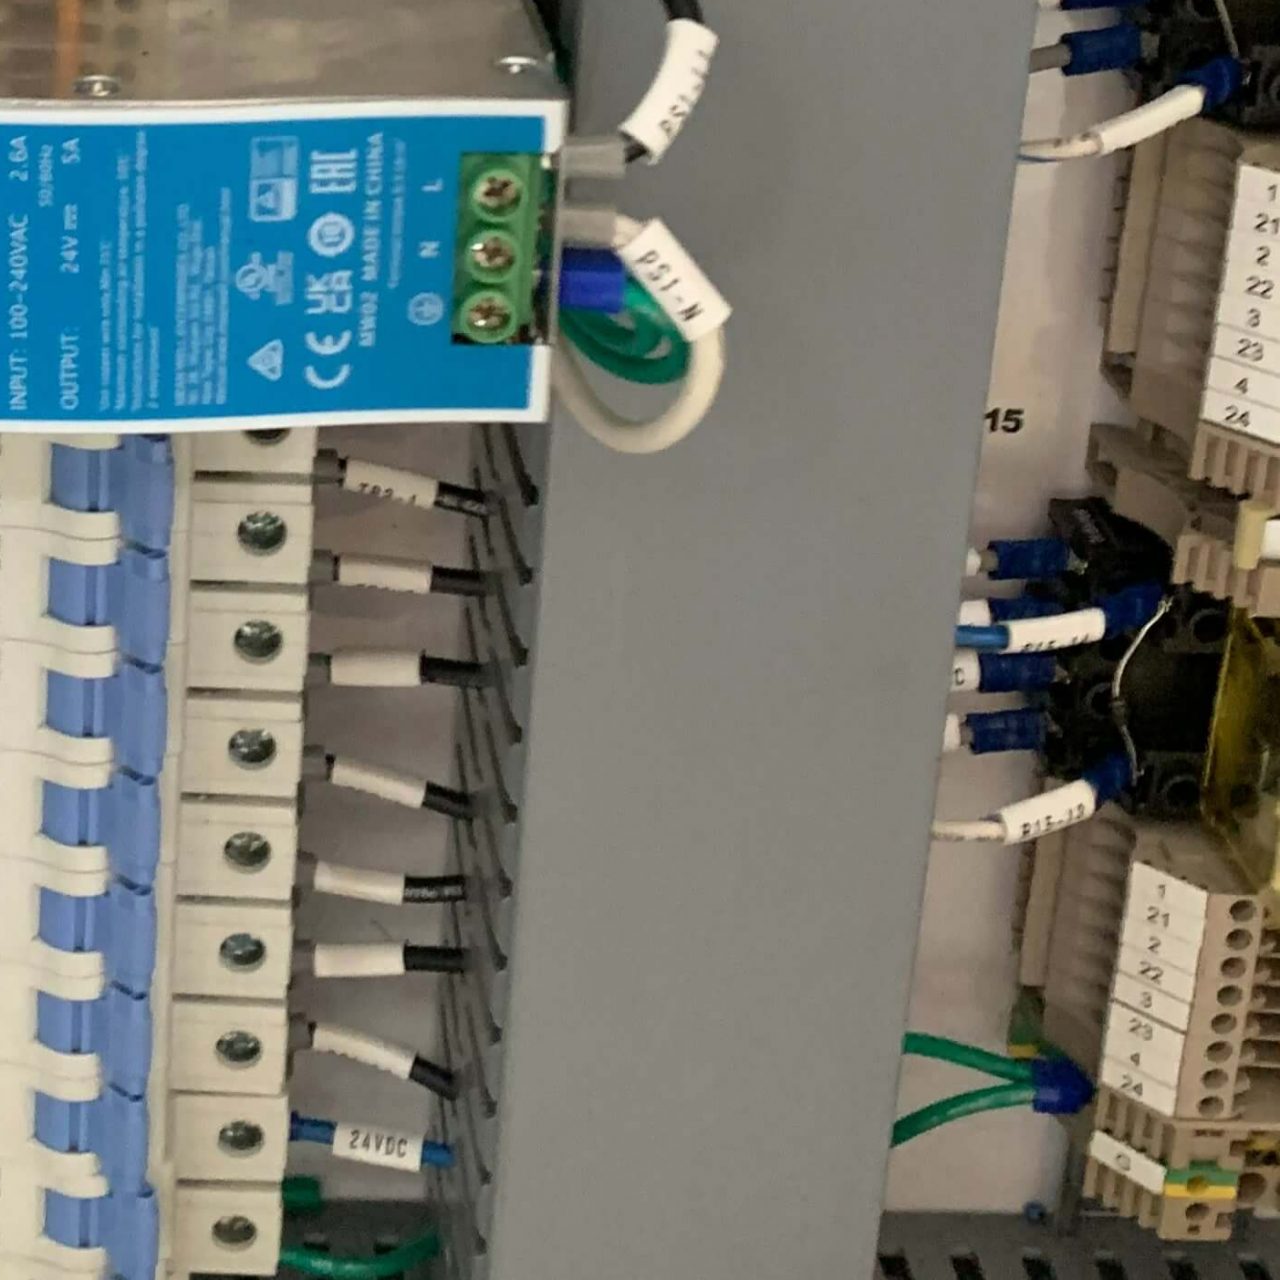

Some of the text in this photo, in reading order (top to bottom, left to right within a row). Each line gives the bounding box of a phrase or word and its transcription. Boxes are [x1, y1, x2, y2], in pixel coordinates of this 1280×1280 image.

[364, 131, 385, 196] CHINA
[421, 177, 442, 192] L
[1267, 184, 1278, 202] 1
[363, 199, 382, 221] IN
[361, 226, 380, 281] MADE
[418, 240, 440, 259] N
[1256, 245, 1271, 266] 2
[8, 135, 29, 410] INPUT: 100-240VAC 2.6A
[59, 137, 81, 410] OUTPUT: 24V 5A
[634, 249, 704, 321] PS1-N
[1244, 275, 1275, 300] 22
[1247, 308, 1262, 328] 3
[1236, 337, 1264, 362] 23
[1234, 377, 1249, 395] 4
[983, 407, 1025, 435] 15
[1224, 404, 1251, 428] 24
[1157, 883, 1167, 901] 1
[1146, 905, 1170, 930] 21
[1147, 936, 1161, 954] 2
[1138, 960, 1165, 986] 22
[1140, 992, 1153, 1009] 3
[1129, 1018, 1154, 1042] 23
[1129, 1051, 1141, 1067] 4
[1121, 1073, 1144, 1098] 24
[348, 1128, 408, 1159] 24VDC
